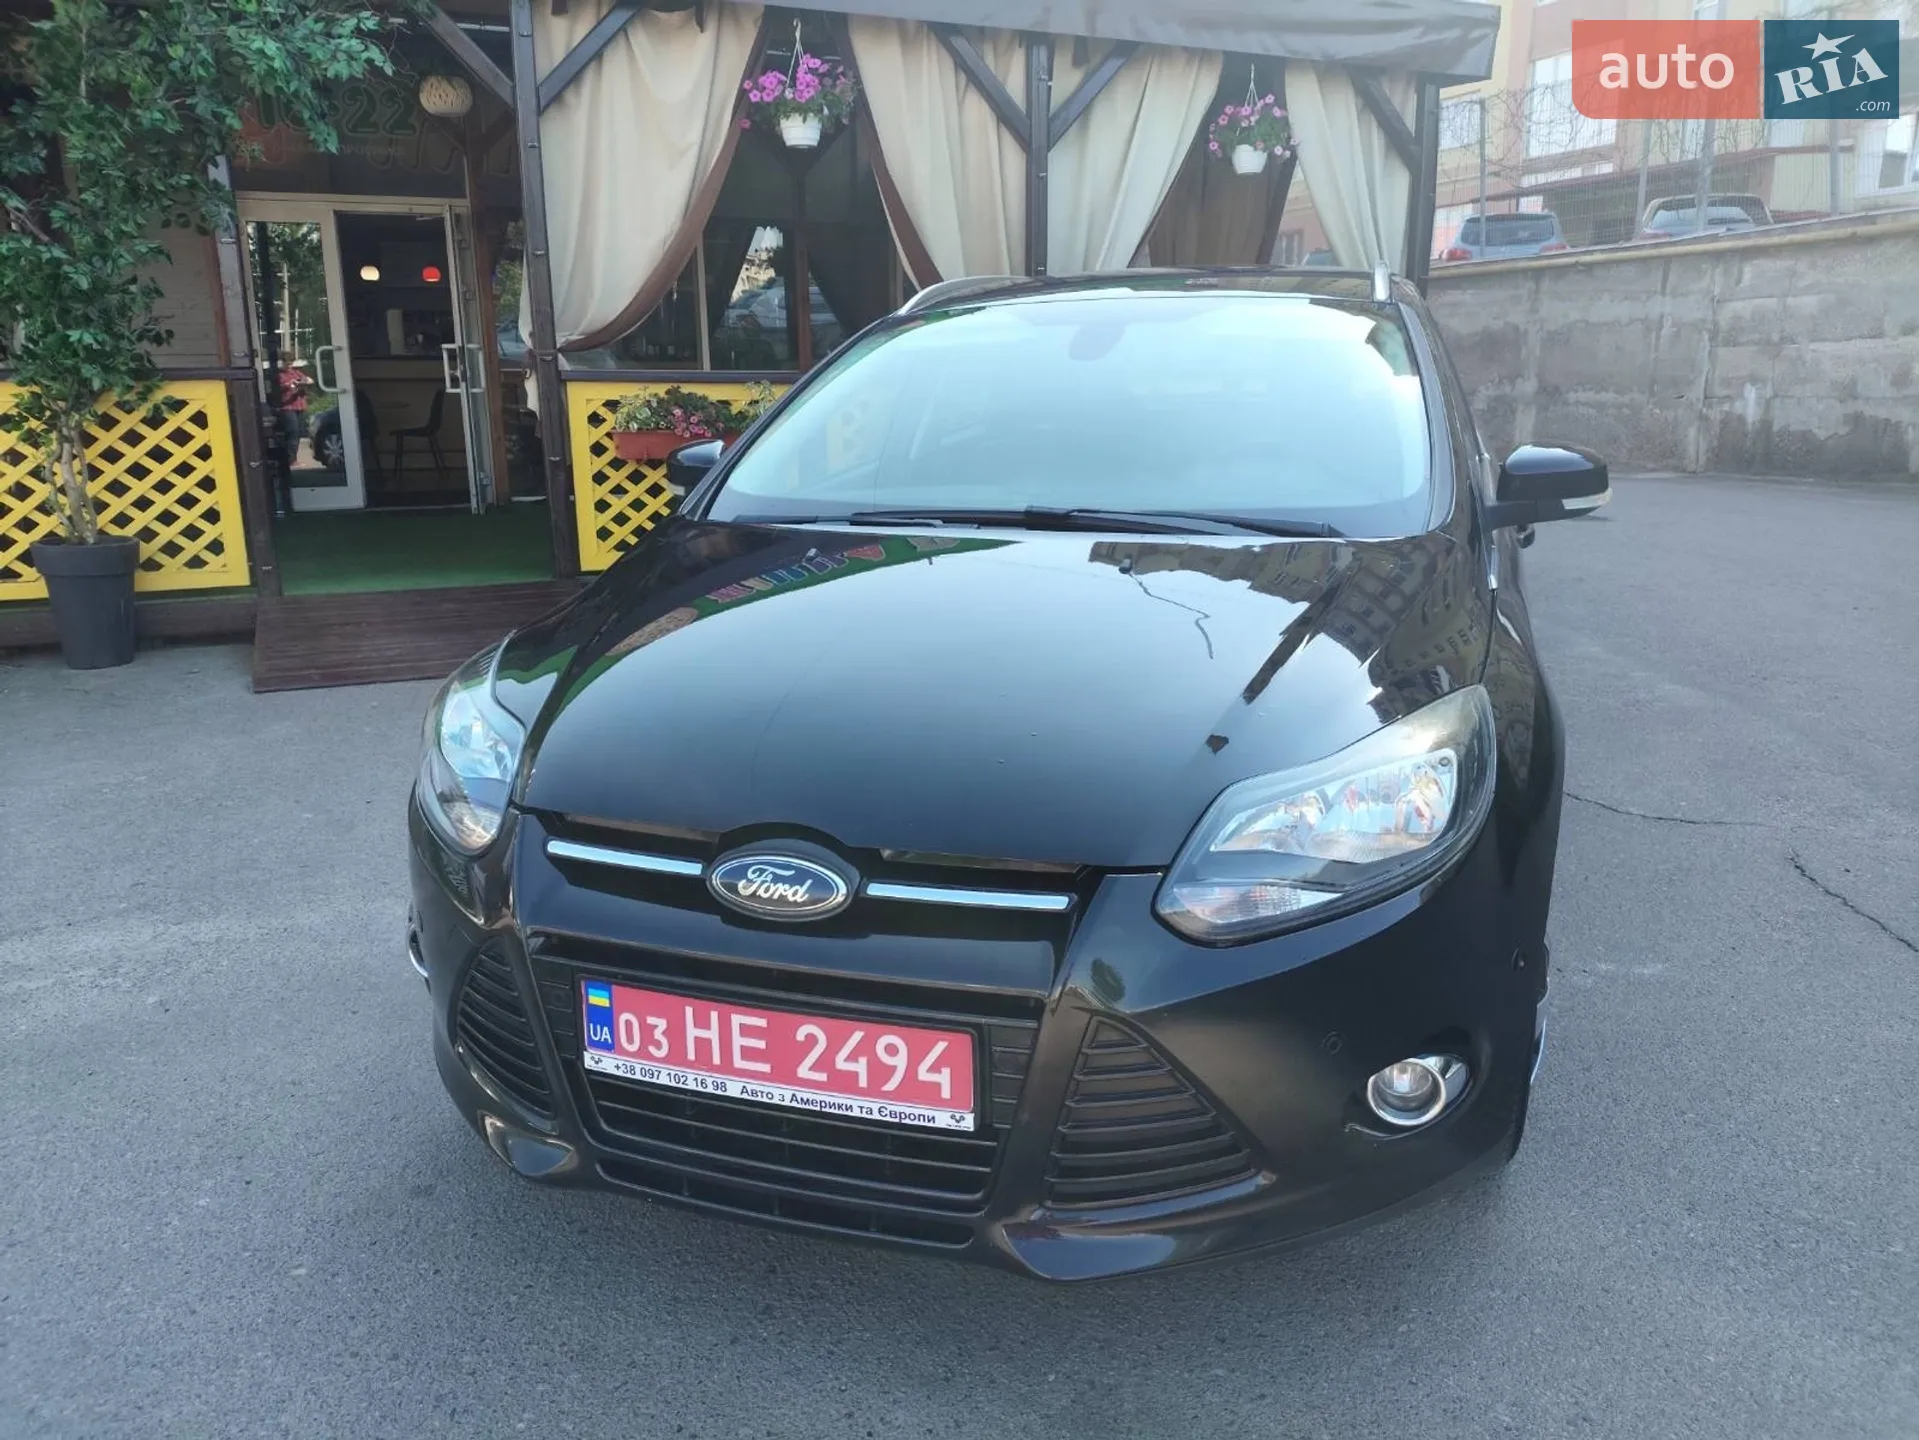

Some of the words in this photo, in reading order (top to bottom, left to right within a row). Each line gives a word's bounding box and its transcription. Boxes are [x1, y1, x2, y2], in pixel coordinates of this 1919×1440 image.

[738, 865, 813, 902] Ford
[589, 1024, 612, 1043] UA
[619, 1012, 670, 1058] 03
[685, 1006, 771, 1073] HE
[796, 1024, 952, 1099] 2494
[614, 1063, 637, 1076] +38
[640, 1067, 662, 1080] 097
[666, 1072, 689, 1087] 102
[694, 1077, 708, 1089] 16
[712, 1079, 728, 1093] 98
[740, 1085, 774, 1101] Авто
[778, 1092, 786, 1102] з
[789, 1093, 854, 1114] Америки
[857, 1104, 874, 1116] та
[878, 1105, 937, 1124] Європи
